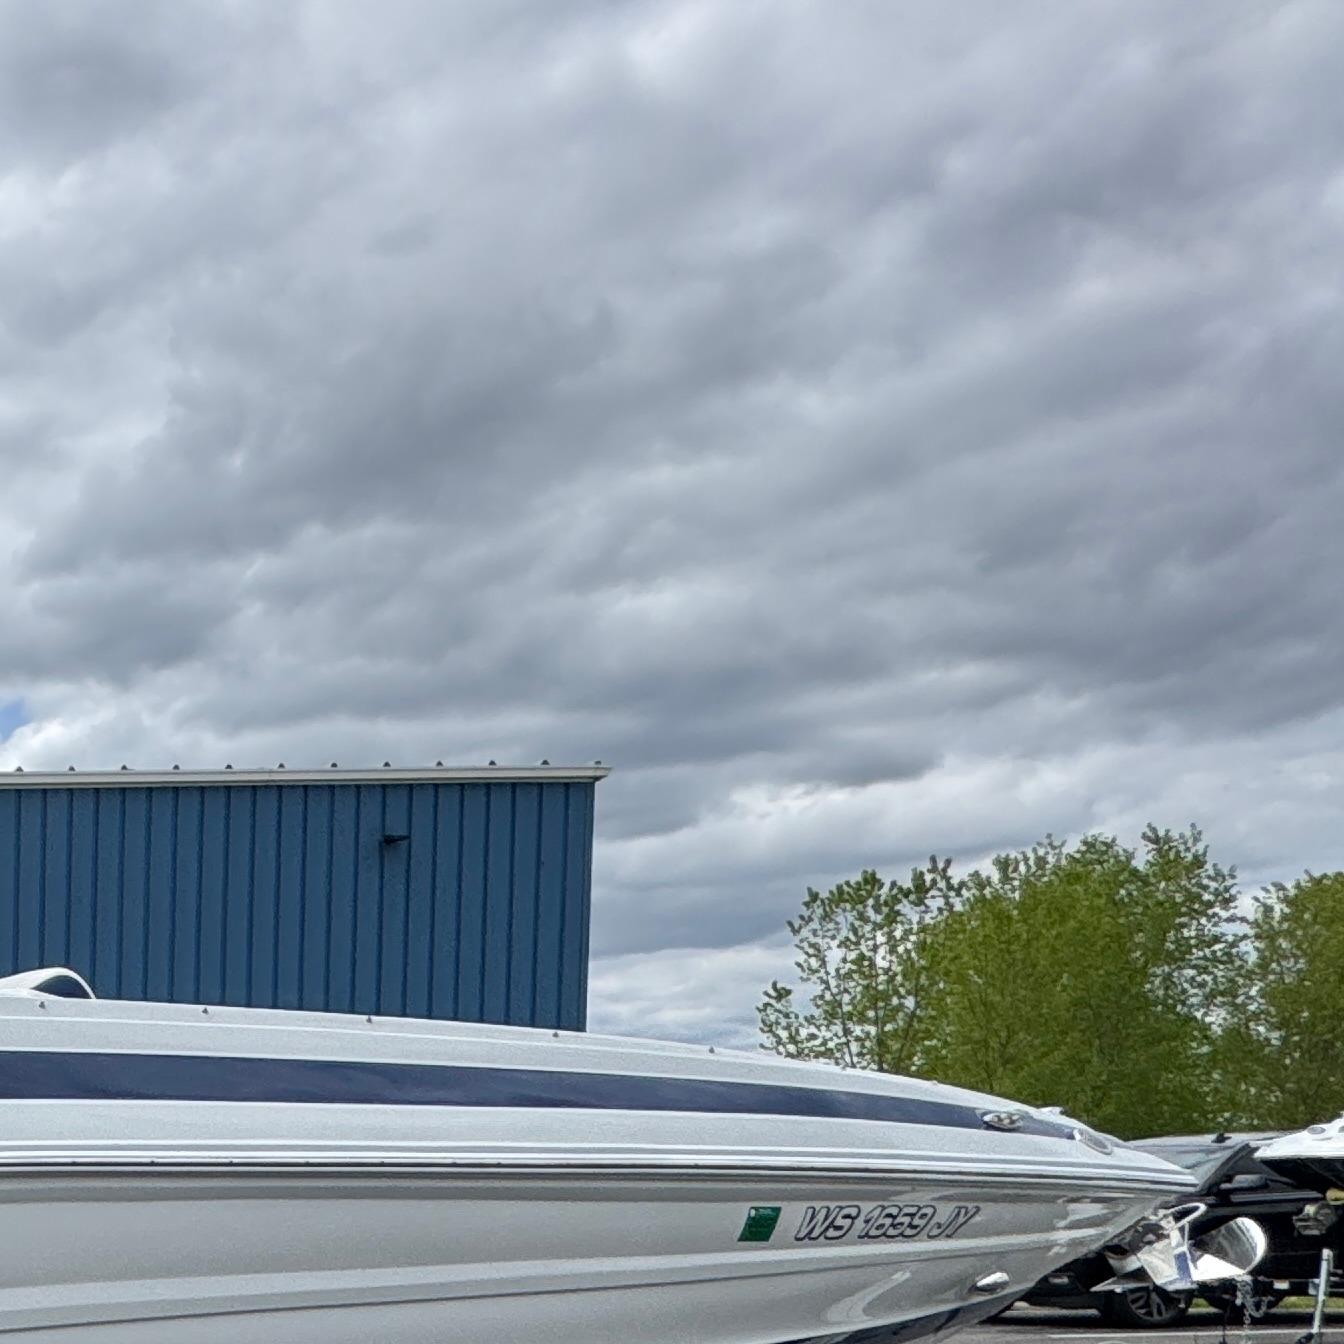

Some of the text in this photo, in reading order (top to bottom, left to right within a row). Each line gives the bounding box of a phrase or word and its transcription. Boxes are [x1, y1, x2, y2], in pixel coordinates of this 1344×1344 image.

[794, 1204, 861, 1241] WS
[858, 1204, 936, 1240] 1659
[928, 1204, 981, 1240] JY
